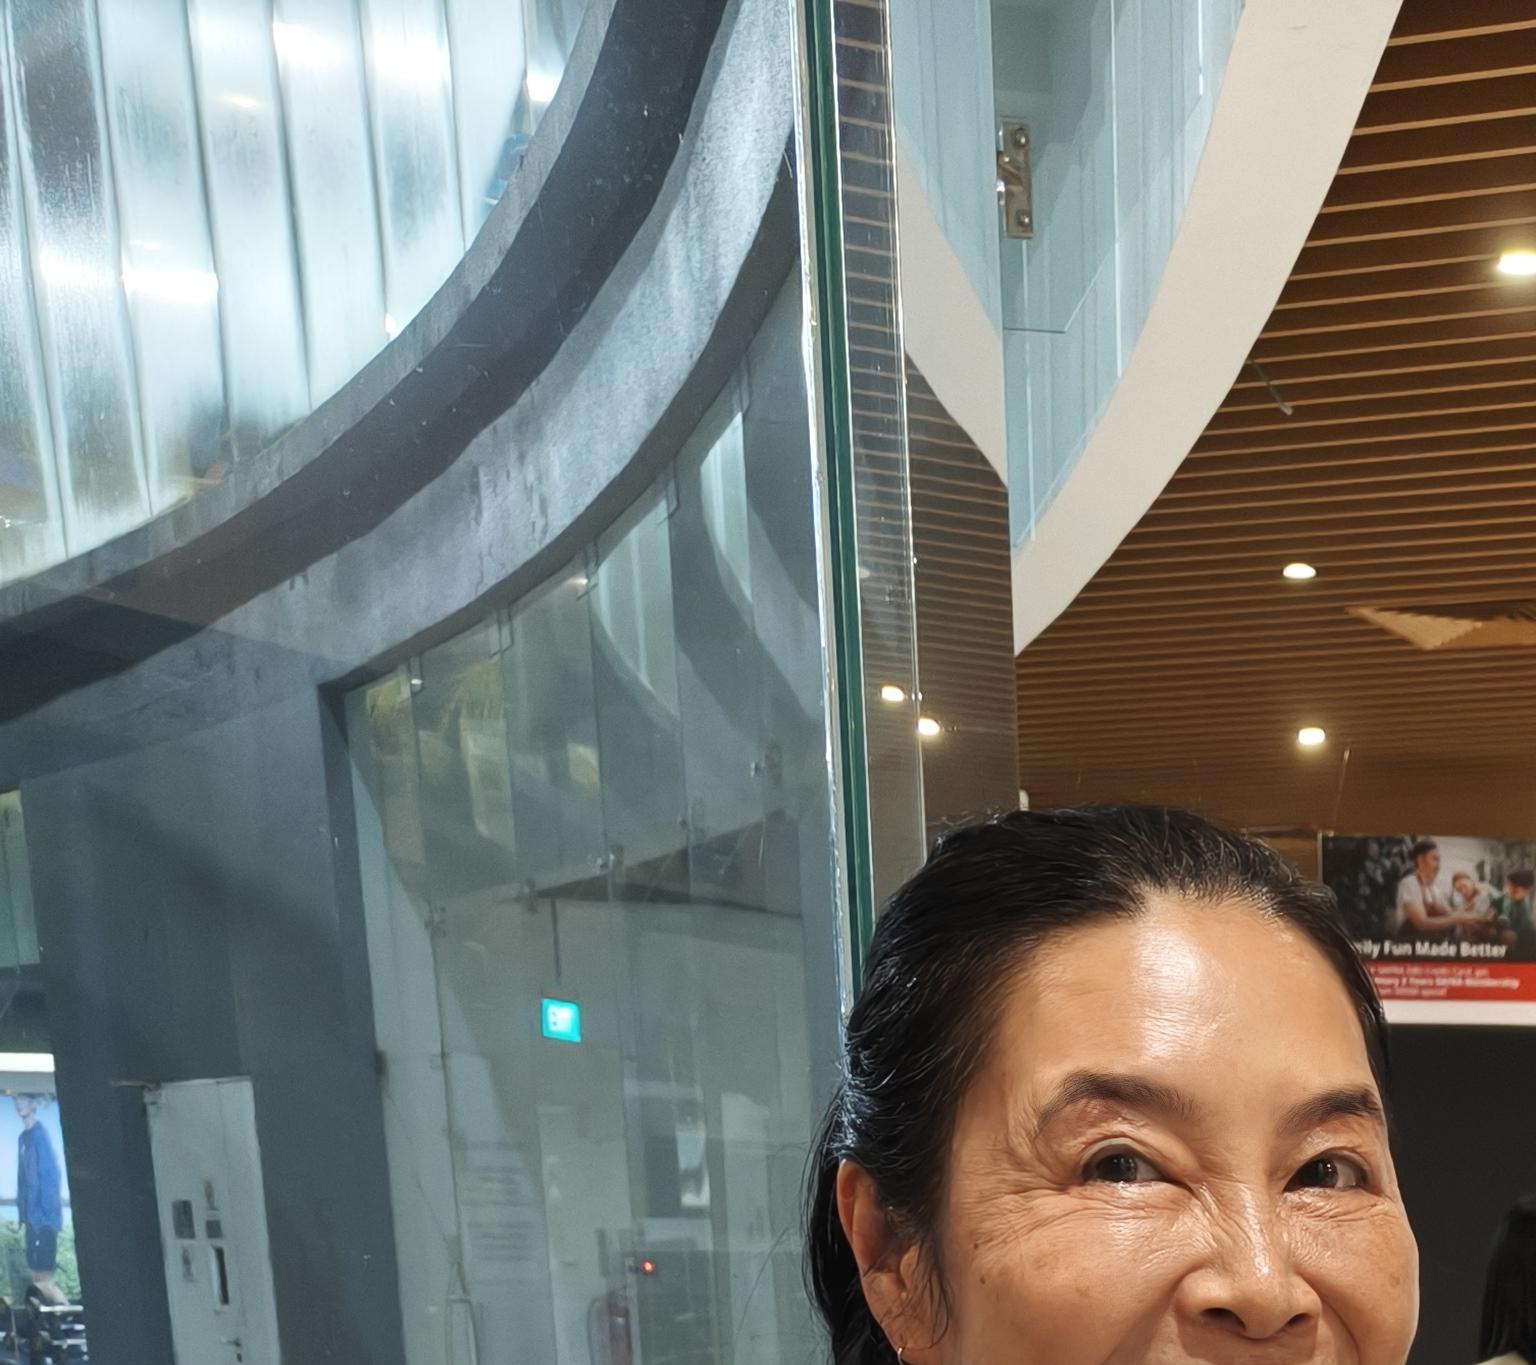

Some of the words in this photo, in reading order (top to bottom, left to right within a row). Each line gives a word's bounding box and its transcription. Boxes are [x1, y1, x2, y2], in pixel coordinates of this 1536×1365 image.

[1383, 940, 1412, 956] Fun
[1415, 940, 1457, 957] Made
[1460, 941, 1507, 958] Better
